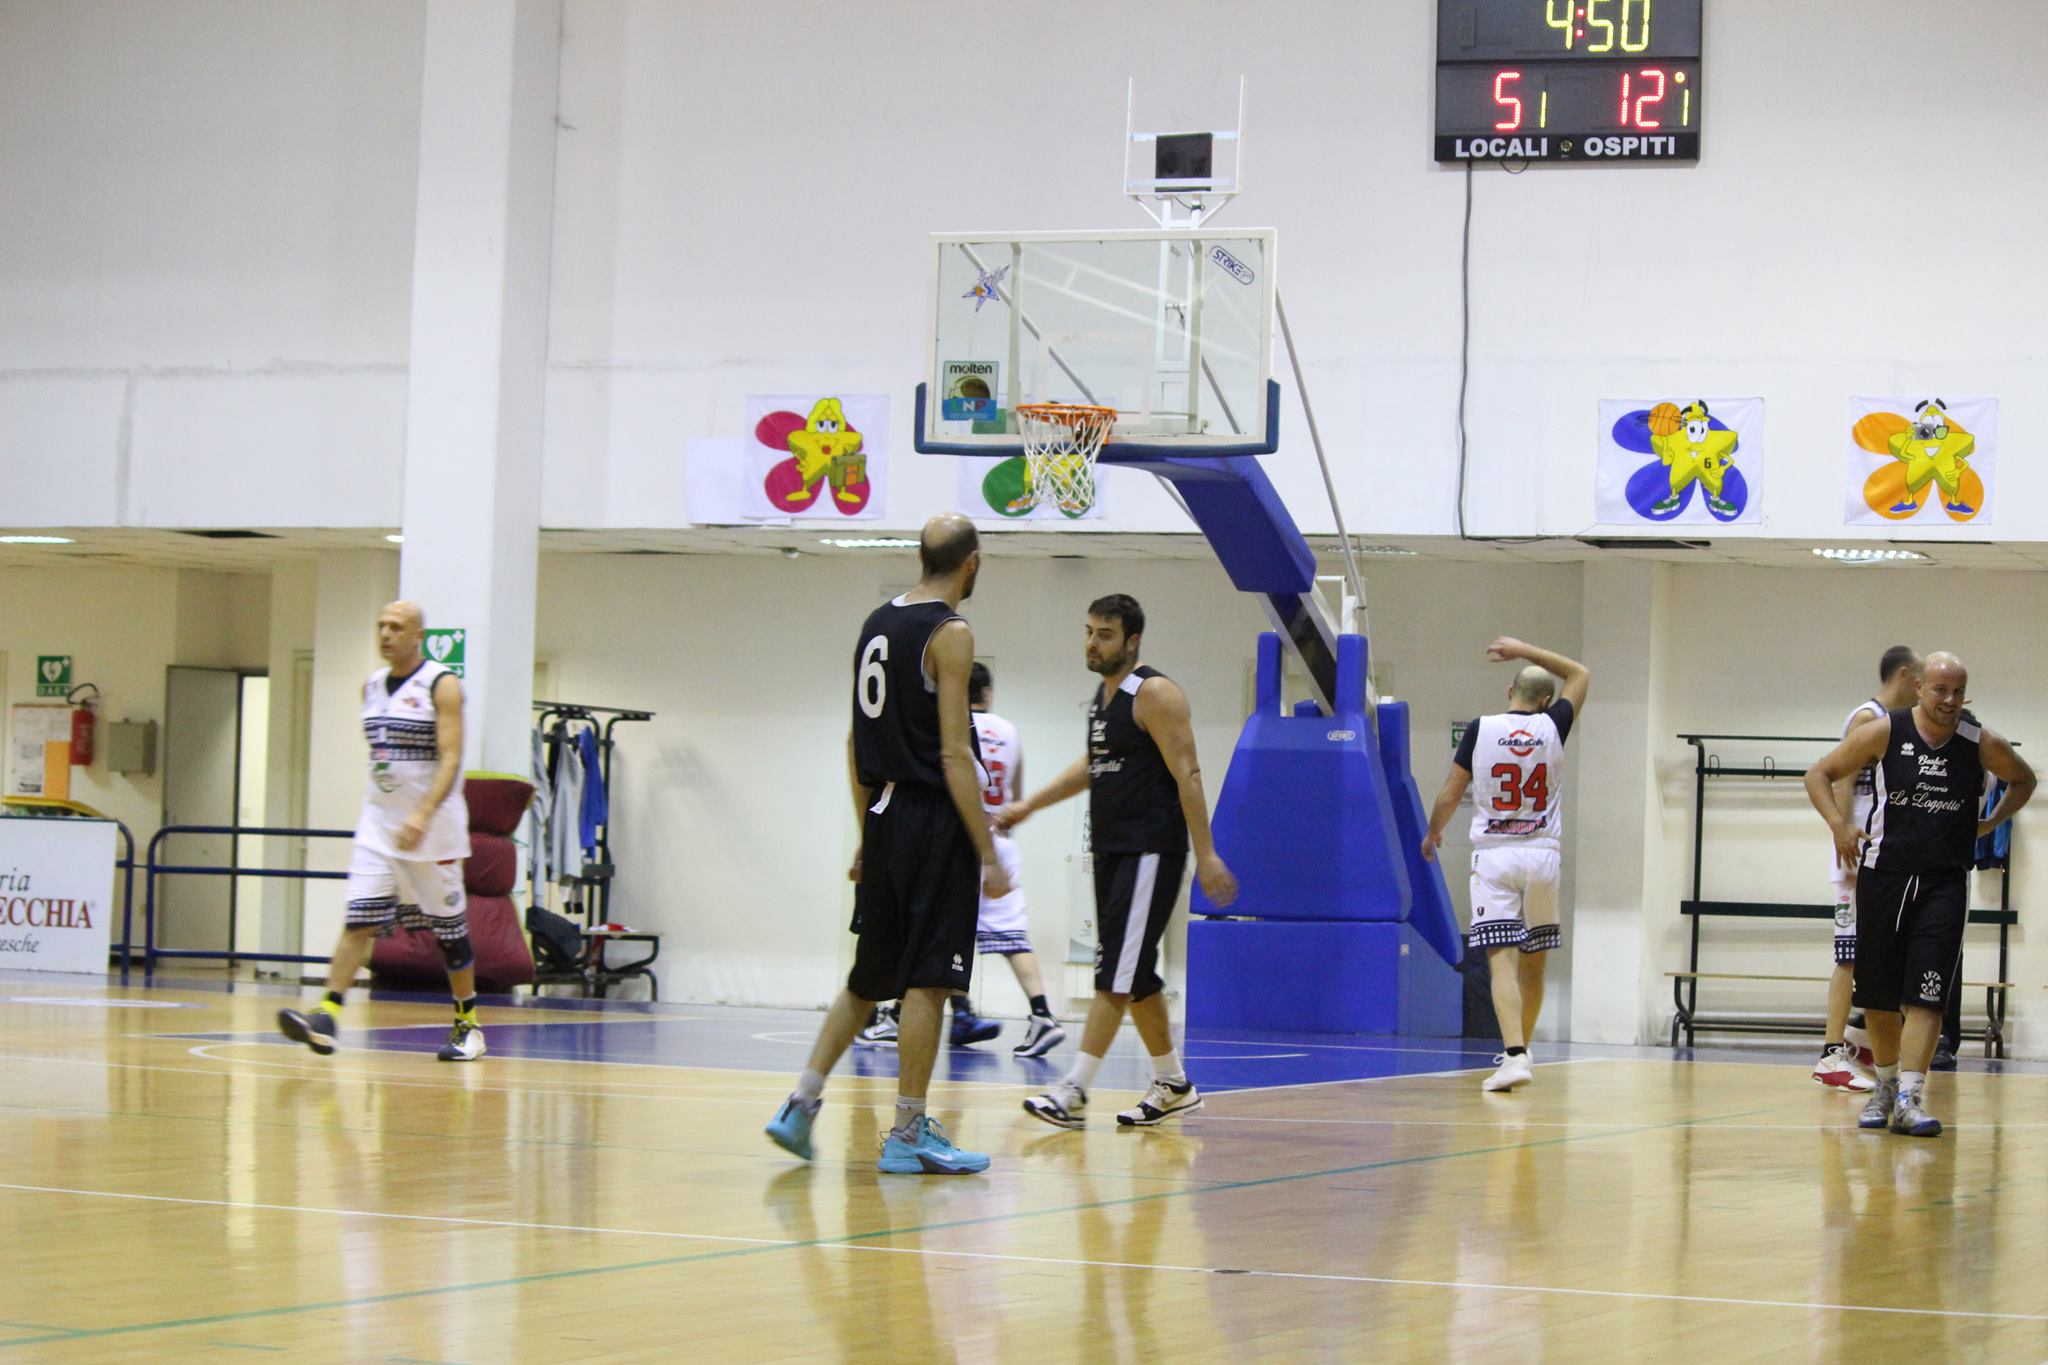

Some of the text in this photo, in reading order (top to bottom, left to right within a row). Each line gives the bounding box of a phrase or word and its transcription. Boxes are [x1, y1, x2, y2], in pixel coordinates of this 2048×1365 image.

[1546, 0, 1651, 52] 4:50
[1455, 136, 1675, 158] LOCALI OSPITI
[949, 363, 993, 374] molten
[1704, 457, 1711, 469] 6
[858, 635, 889, 719] 6
[1491, 763, 1548, 812] 34
[1889, 789, 1908, 806] La
[0, 866, 30, 891] ria
